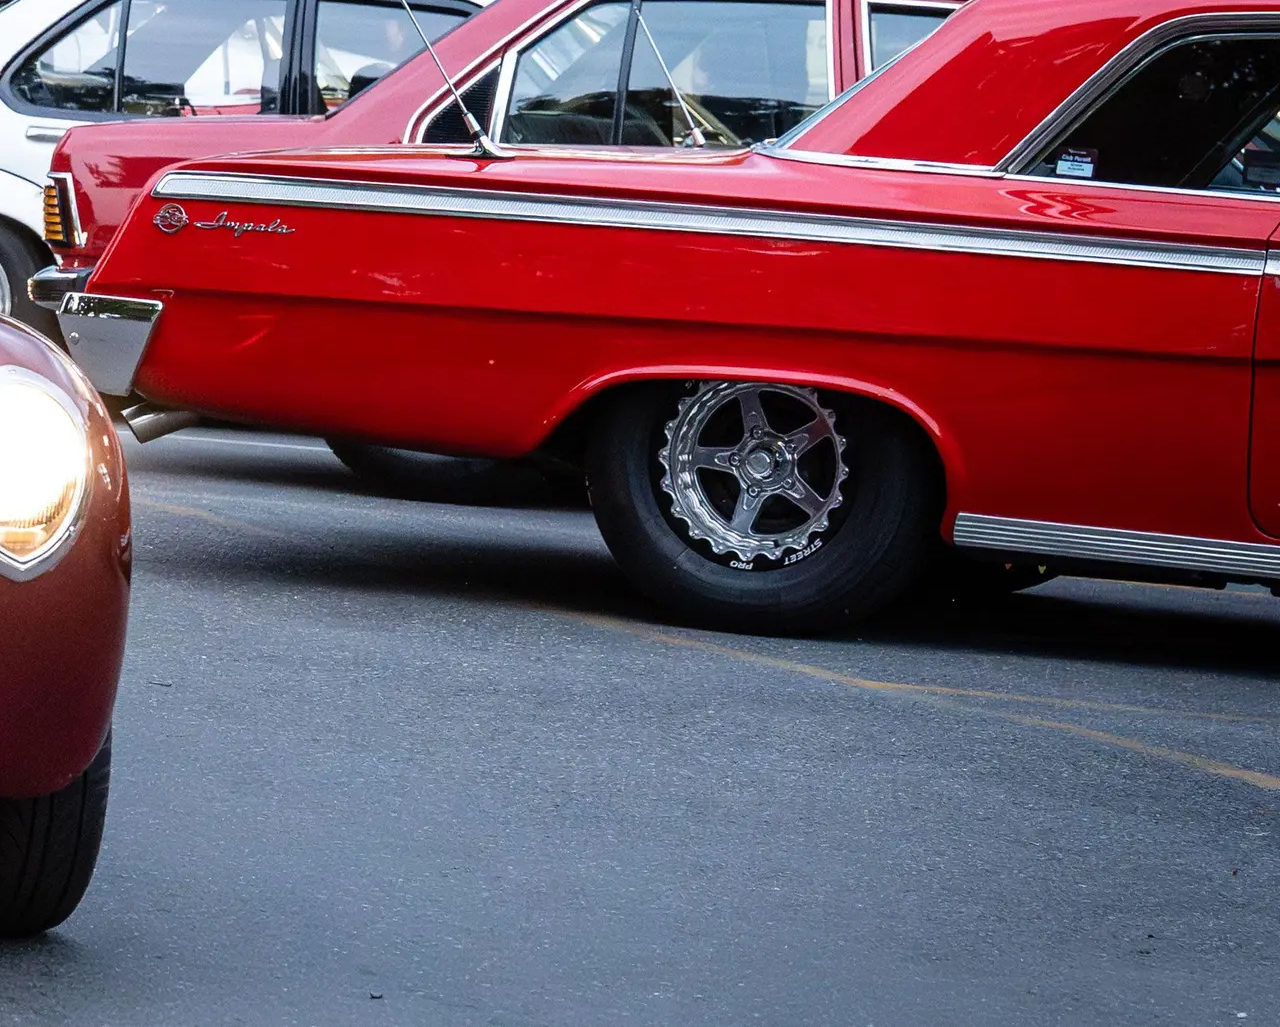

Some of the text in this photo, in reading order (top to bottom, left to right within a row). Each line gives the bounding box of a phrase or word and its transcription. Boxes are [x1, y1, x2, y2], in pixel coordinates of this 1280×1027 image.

[194, 210, 296, 238] Impala
[729, 538, 823, 570] STREET PRO
